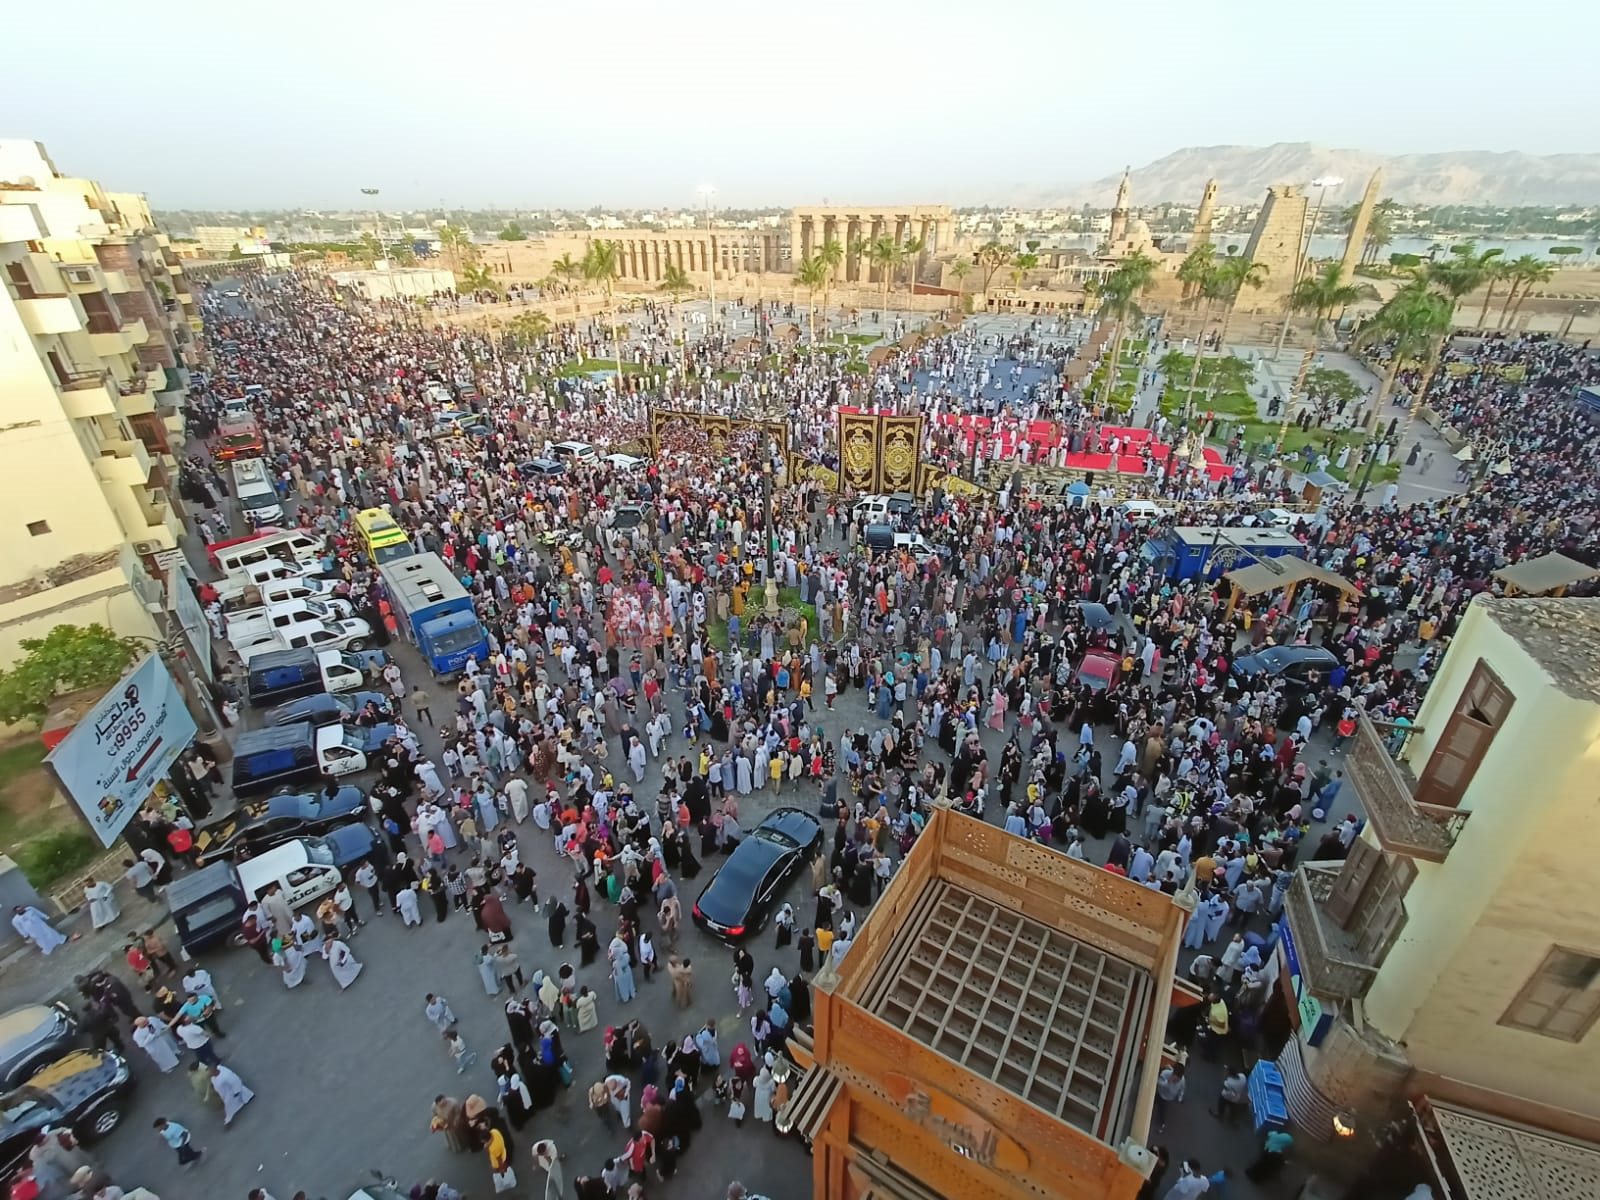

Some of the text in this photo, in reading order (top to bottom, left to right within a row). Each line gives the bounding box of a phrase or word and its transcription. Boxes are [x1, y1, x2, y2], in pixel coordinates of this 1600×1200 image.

[92, 700, 130, 745] دلمار
[113, 708, 146, 749] 19955
[135, 727, 154, 753] العروض
[120, 750, 135, 770] طوال
[103, 767, 121, 790] السنة
